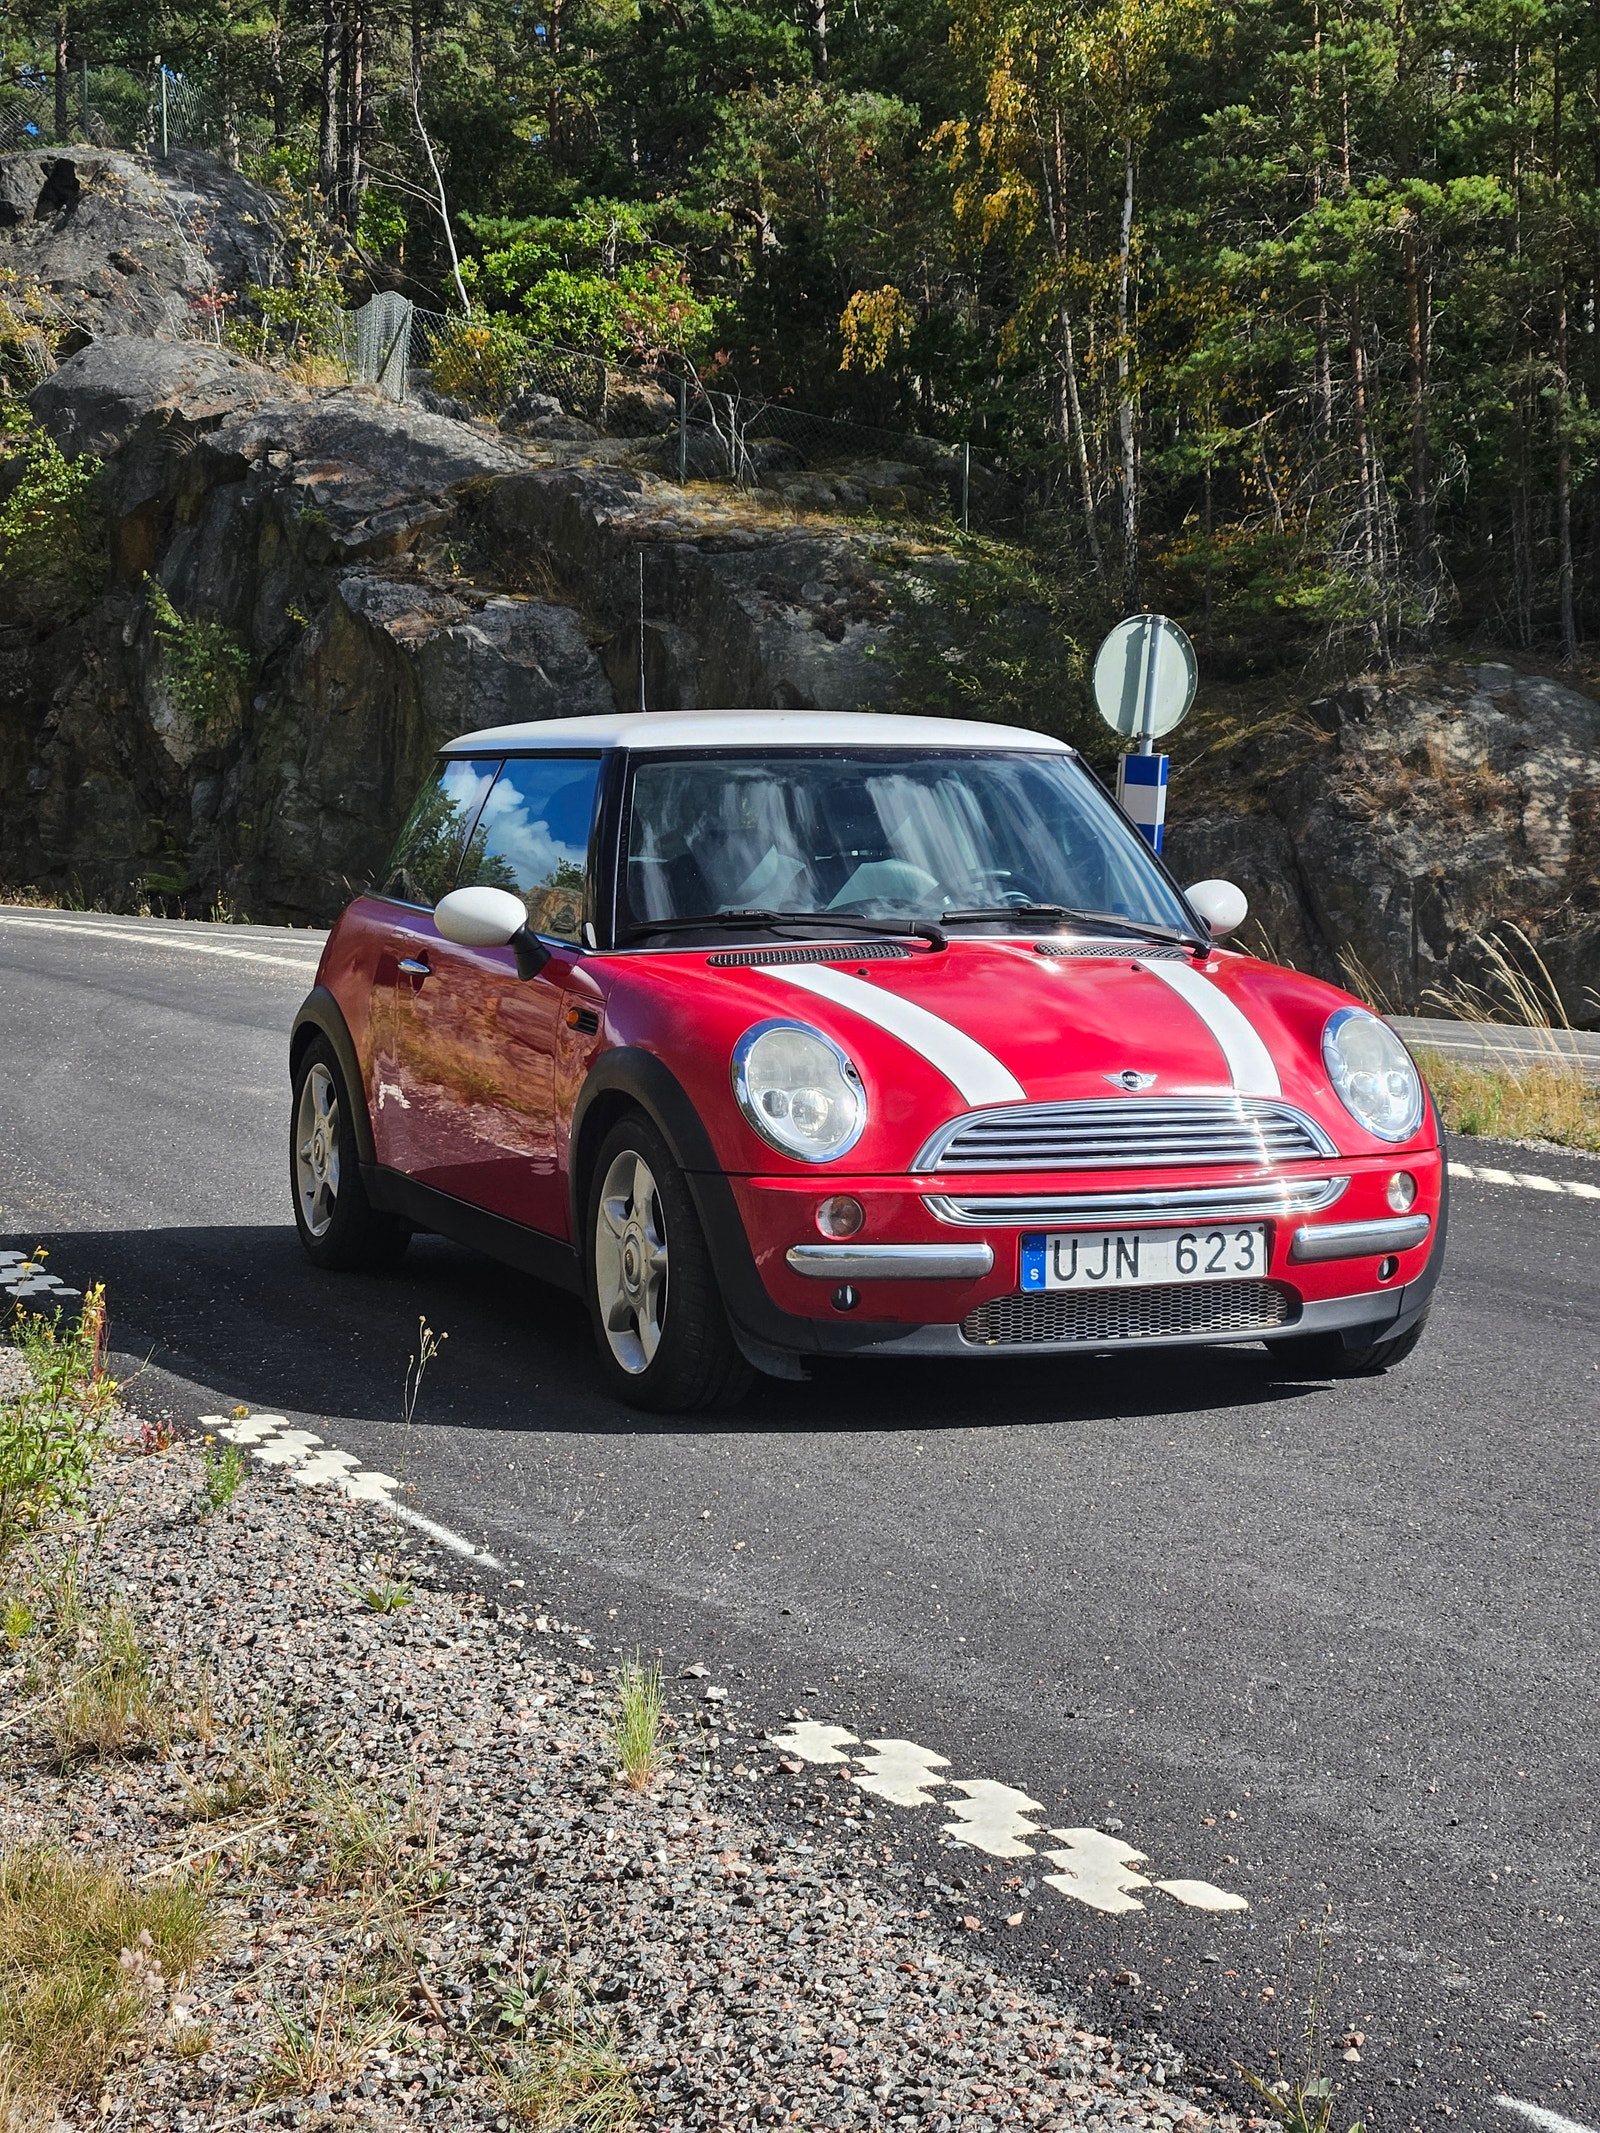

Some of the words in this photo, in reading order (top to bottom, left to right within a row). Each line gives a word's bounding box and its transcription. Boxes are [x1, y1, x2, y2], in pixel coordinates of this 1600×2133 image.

[1053, 1236, 1140, 1282] UJN
[1176, 1229, 1255, 1275] 623
[1030, 1268, 1039, 1280] S
